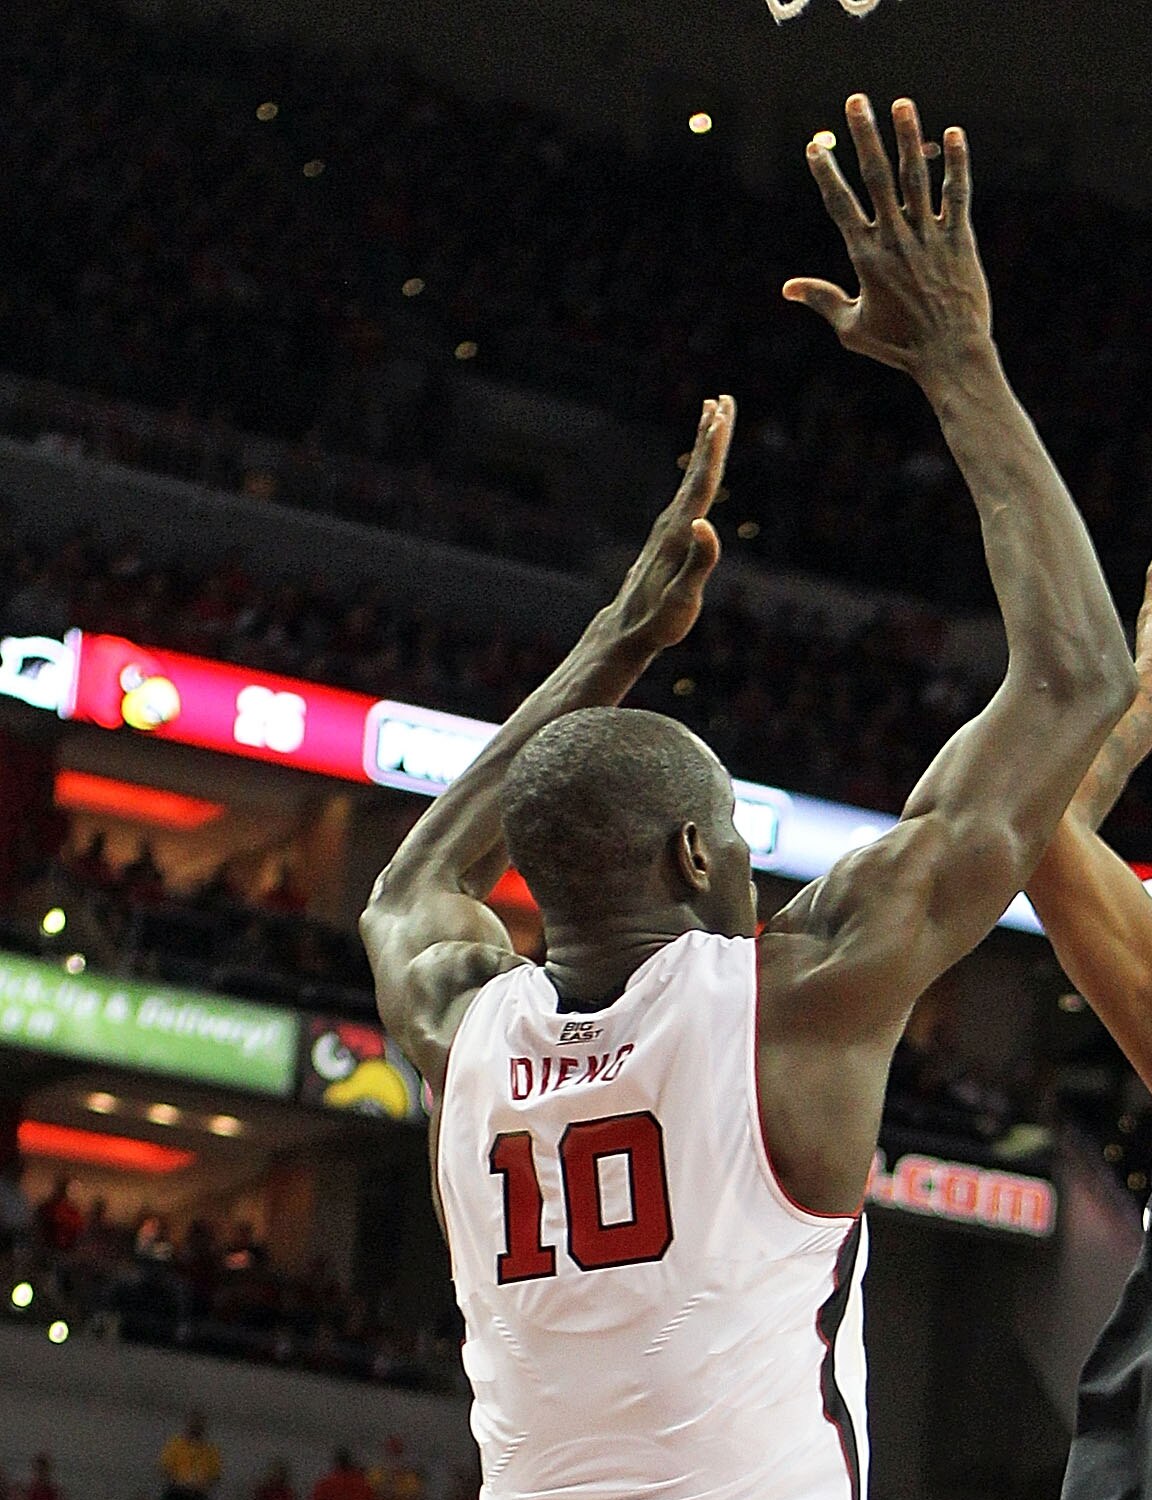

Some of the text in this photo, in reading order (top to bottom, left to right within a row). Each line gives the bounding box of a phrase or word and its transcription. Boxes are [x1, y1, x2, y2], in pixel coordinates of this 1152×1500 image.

[559, 1028, 605, 1041] EAST
[563, 1021, 595, 1032] BIG
[509, 1043, 635, 1101] DIENG
[489, 1110, 674, 1286] 10
